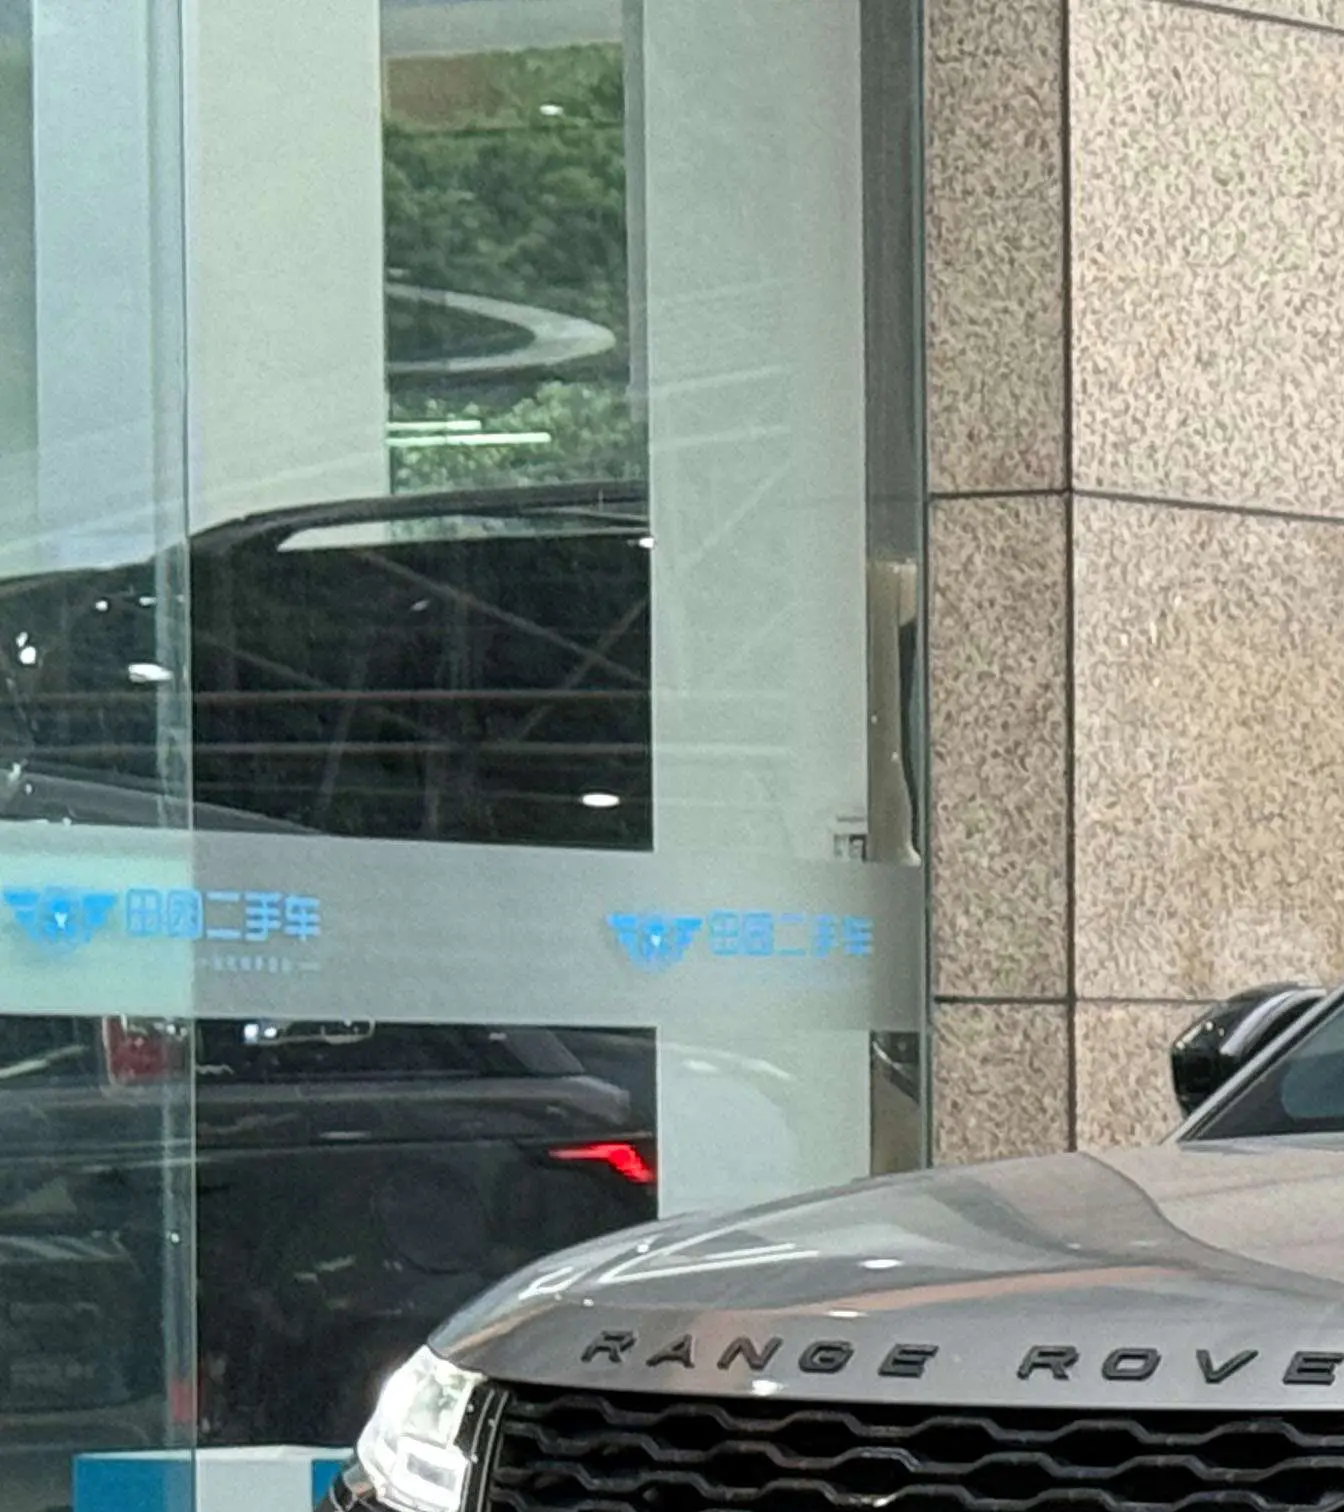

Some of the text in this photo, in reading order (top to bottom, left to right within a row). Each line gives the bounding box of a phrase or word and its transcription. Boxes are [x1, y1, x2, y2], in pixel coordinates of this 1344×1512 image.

[126, 888, 322, 942] 田园二手车
[580, 1330, 940, 1379] RANGE
